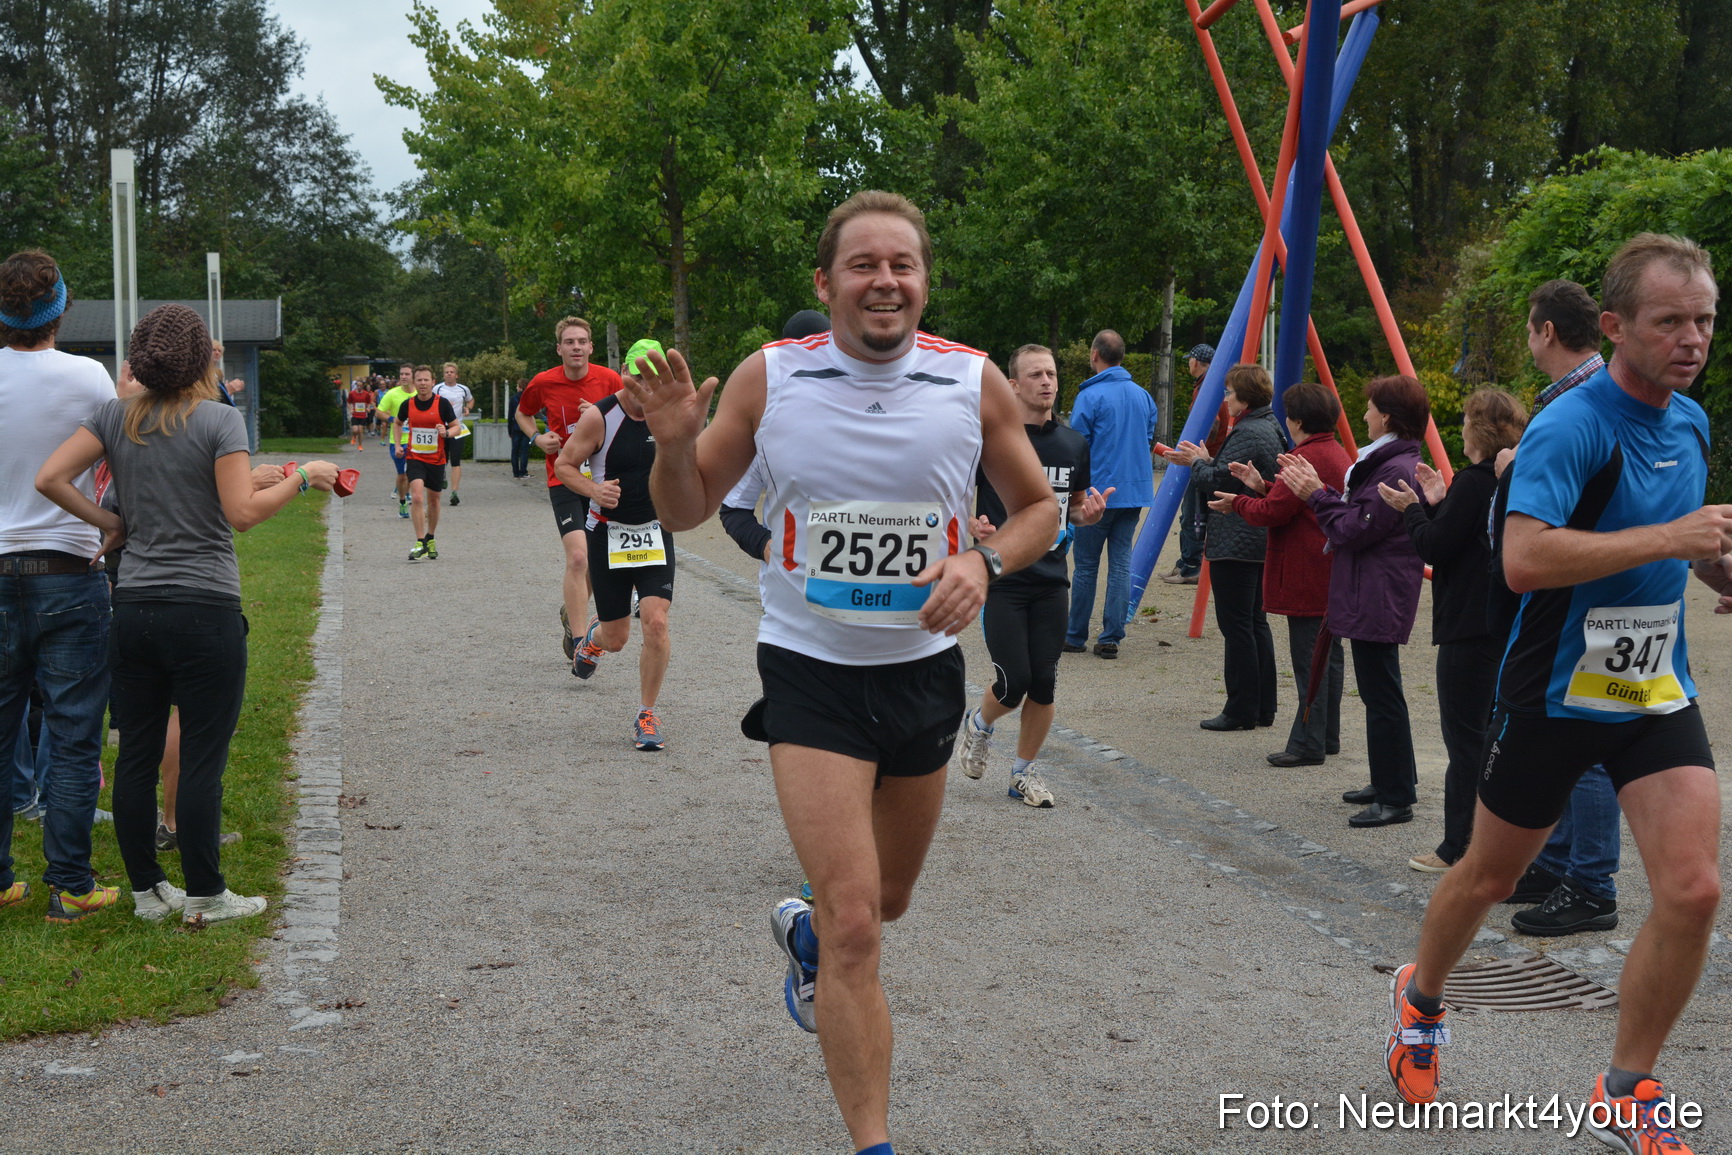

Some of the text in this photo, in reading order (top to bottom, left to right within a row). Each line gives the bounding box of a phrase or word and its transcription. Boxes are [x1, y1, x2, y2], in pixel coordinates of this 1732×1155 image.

[416, 434, 433, 444] 613
[810, 512, 921, 526] PARTL Neumarkt
[620, 532, 653, 549] 294
[627, 553, 648, 561] Bernd
[820, 530, 928, 577] 2525
[851, 588, 892, 606] Gerd
[1587, 619, 1630, 631] PARTL
[1605, 632, 1669, 675] 347
